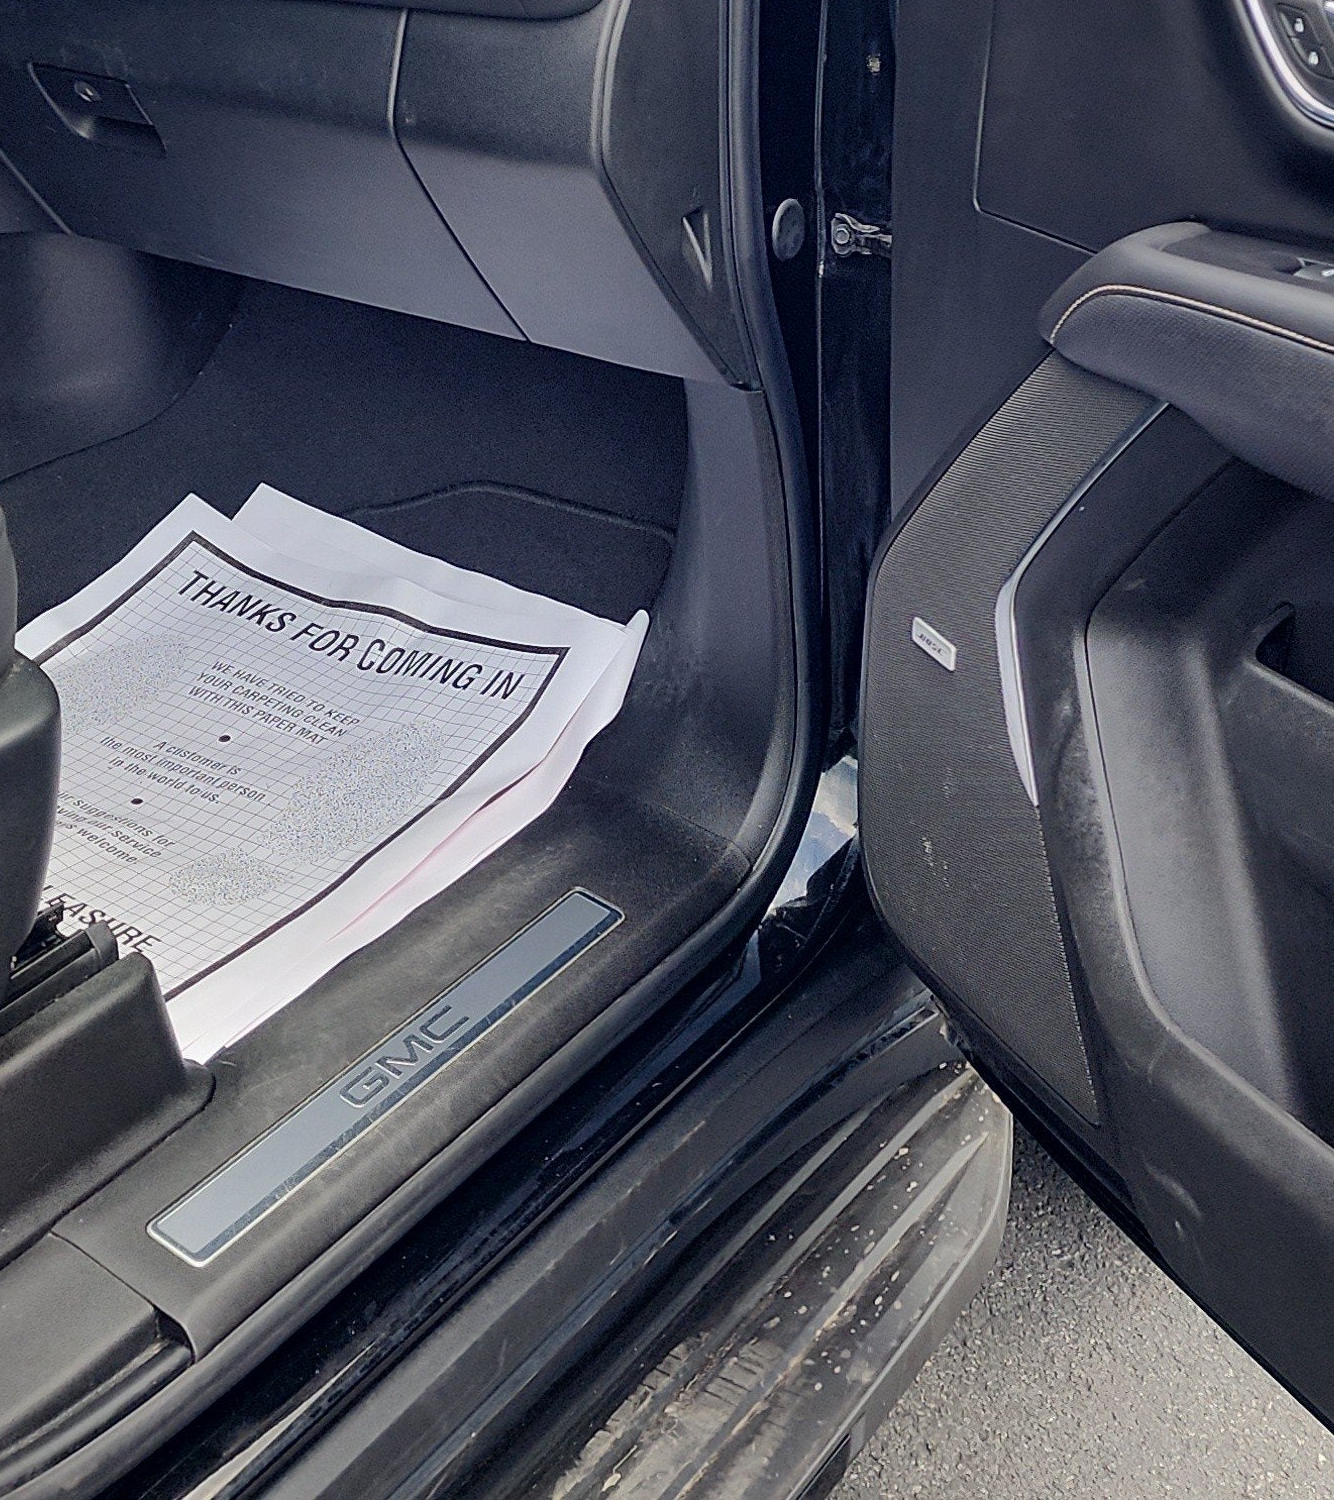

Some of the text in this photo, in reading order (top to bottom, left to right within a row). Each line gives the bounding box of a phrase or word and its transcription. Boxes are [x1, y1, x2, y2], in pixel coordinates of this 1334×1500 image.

[178, 570, 526, 700] THANKS FOR COMING IN
[188, 686, 329, 745] WITH THIS PAPER MAT
[196, 672, 348, 737] YOUR CARPETING CLEAN
[211, 660, 360, 726] WE HAVE TRIED TO KEEP
[100, 736, 266, 801] the most important person
[108, 756, 125, 767] in
[123, 762, 147, 776] the
[147, 771, 188, 790] world
[185, 784, 201, 795] to
[152, 741, 242, 775] A customer is
[72, 799, 153, 838] suggestions
[151, 834, 177, 847] for
[77, 828, 138, 865] welcome.
[87, 820, 114, 831] our
[110, 829, 162, 858] service
[42, 884, 162, 953] EASURE
[339, 1004, 469, 1108] GMC
